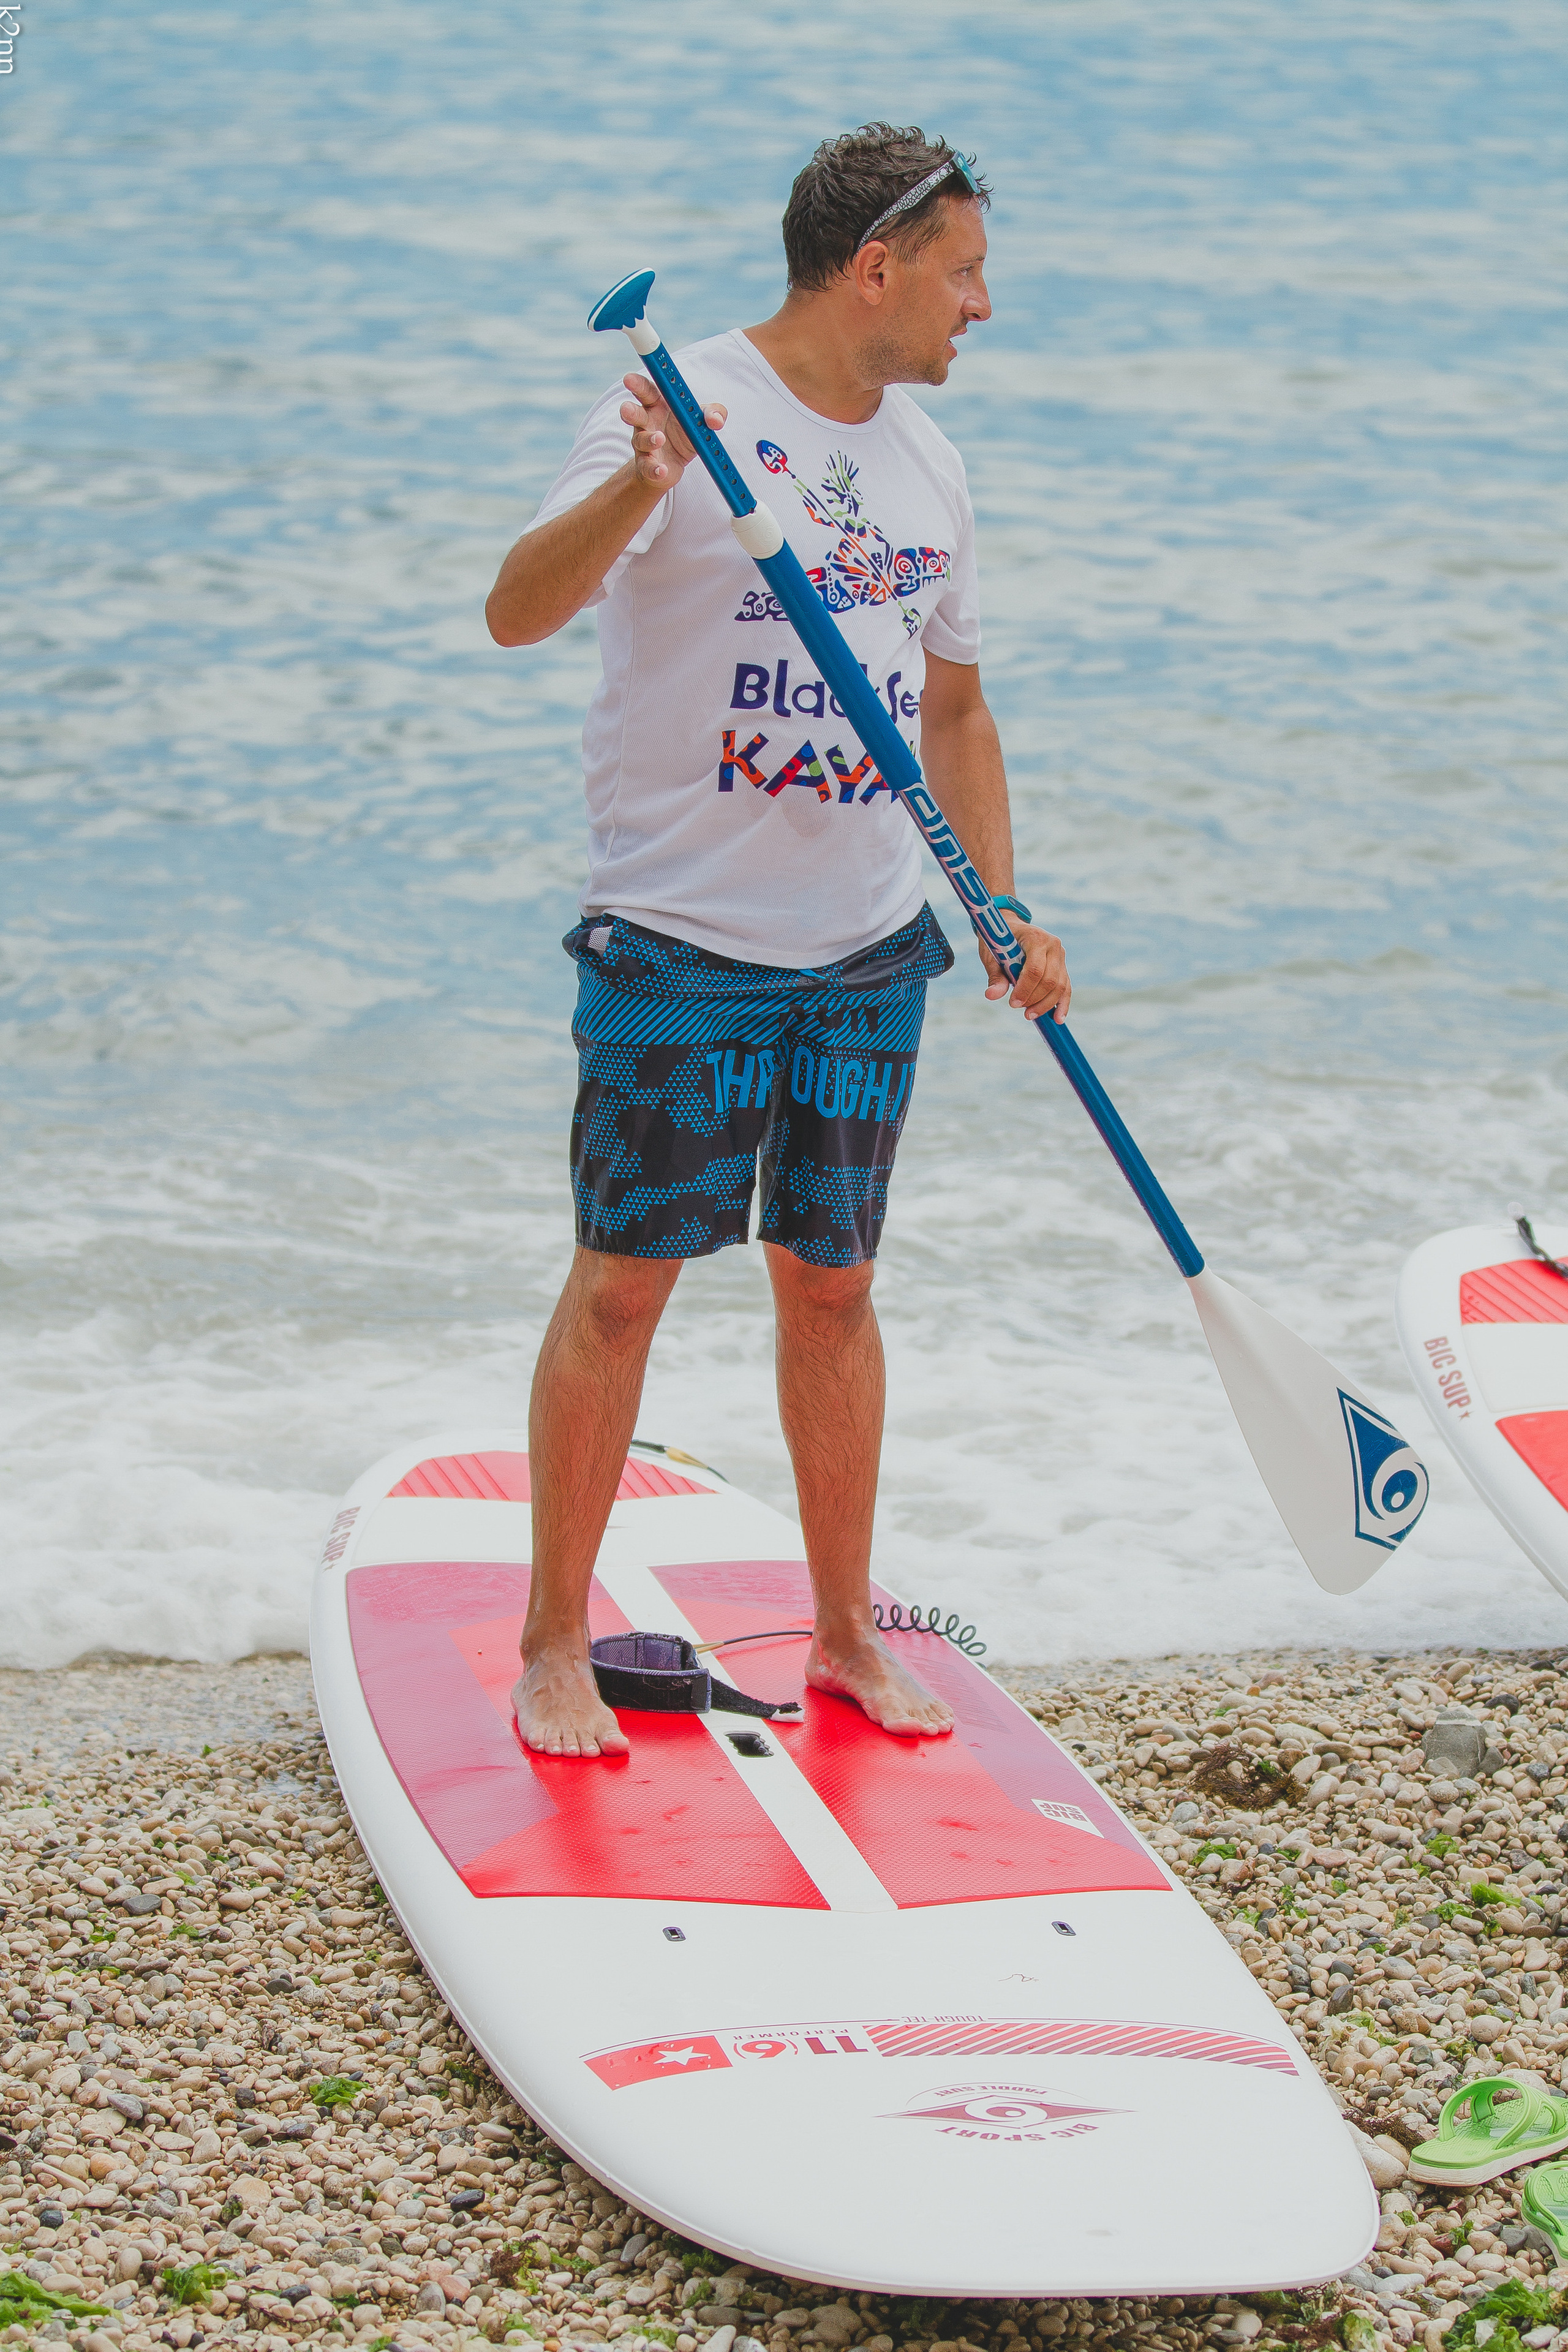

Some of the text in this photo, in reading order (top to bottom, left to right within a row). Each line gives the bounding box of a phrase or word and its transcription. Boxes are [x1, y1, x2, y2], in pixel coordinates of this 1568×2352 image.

[886, 671, 923, 725] Se
[1424, 1336, 1471, 1408] BIC SUP
[322, 1507, 361, 1564] BIC SUP
[1039, 1803, 1080, 1814] SUP
[1044, 1809, 1088, 1822] BIC
[733, 2028, 849, 2040] PERFORMER
[934, 2085, 1049, 2097] PADDLE SURF
[935, 2123, 1099, 2141] BIC SPORT
